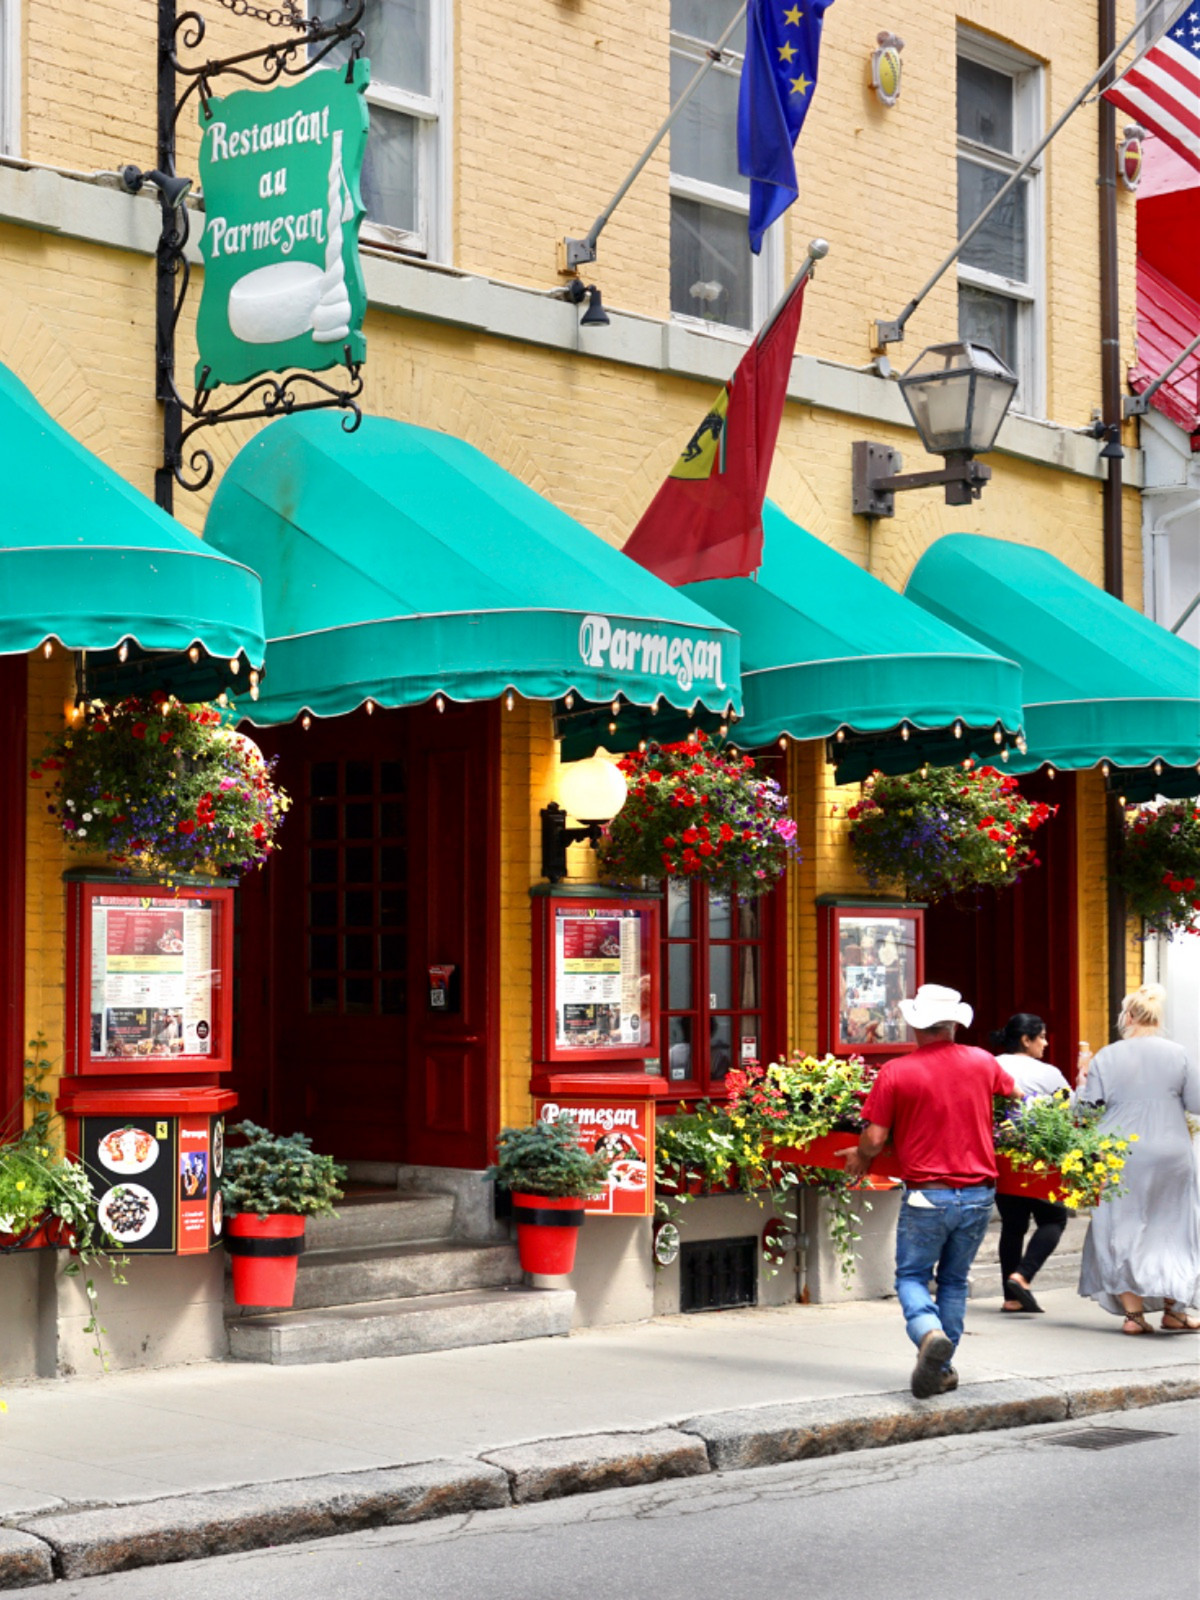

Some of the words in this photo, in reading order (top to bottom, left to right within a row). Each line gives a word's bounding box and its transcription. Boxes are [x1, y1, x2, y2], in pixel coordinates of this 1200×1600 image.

[207, 105, 331, 163] Restaurant
[259, 166, 287, 199] au
[207, 207, 327, 259] Parmesan
[579, 615, 726, 691] Parmesan
